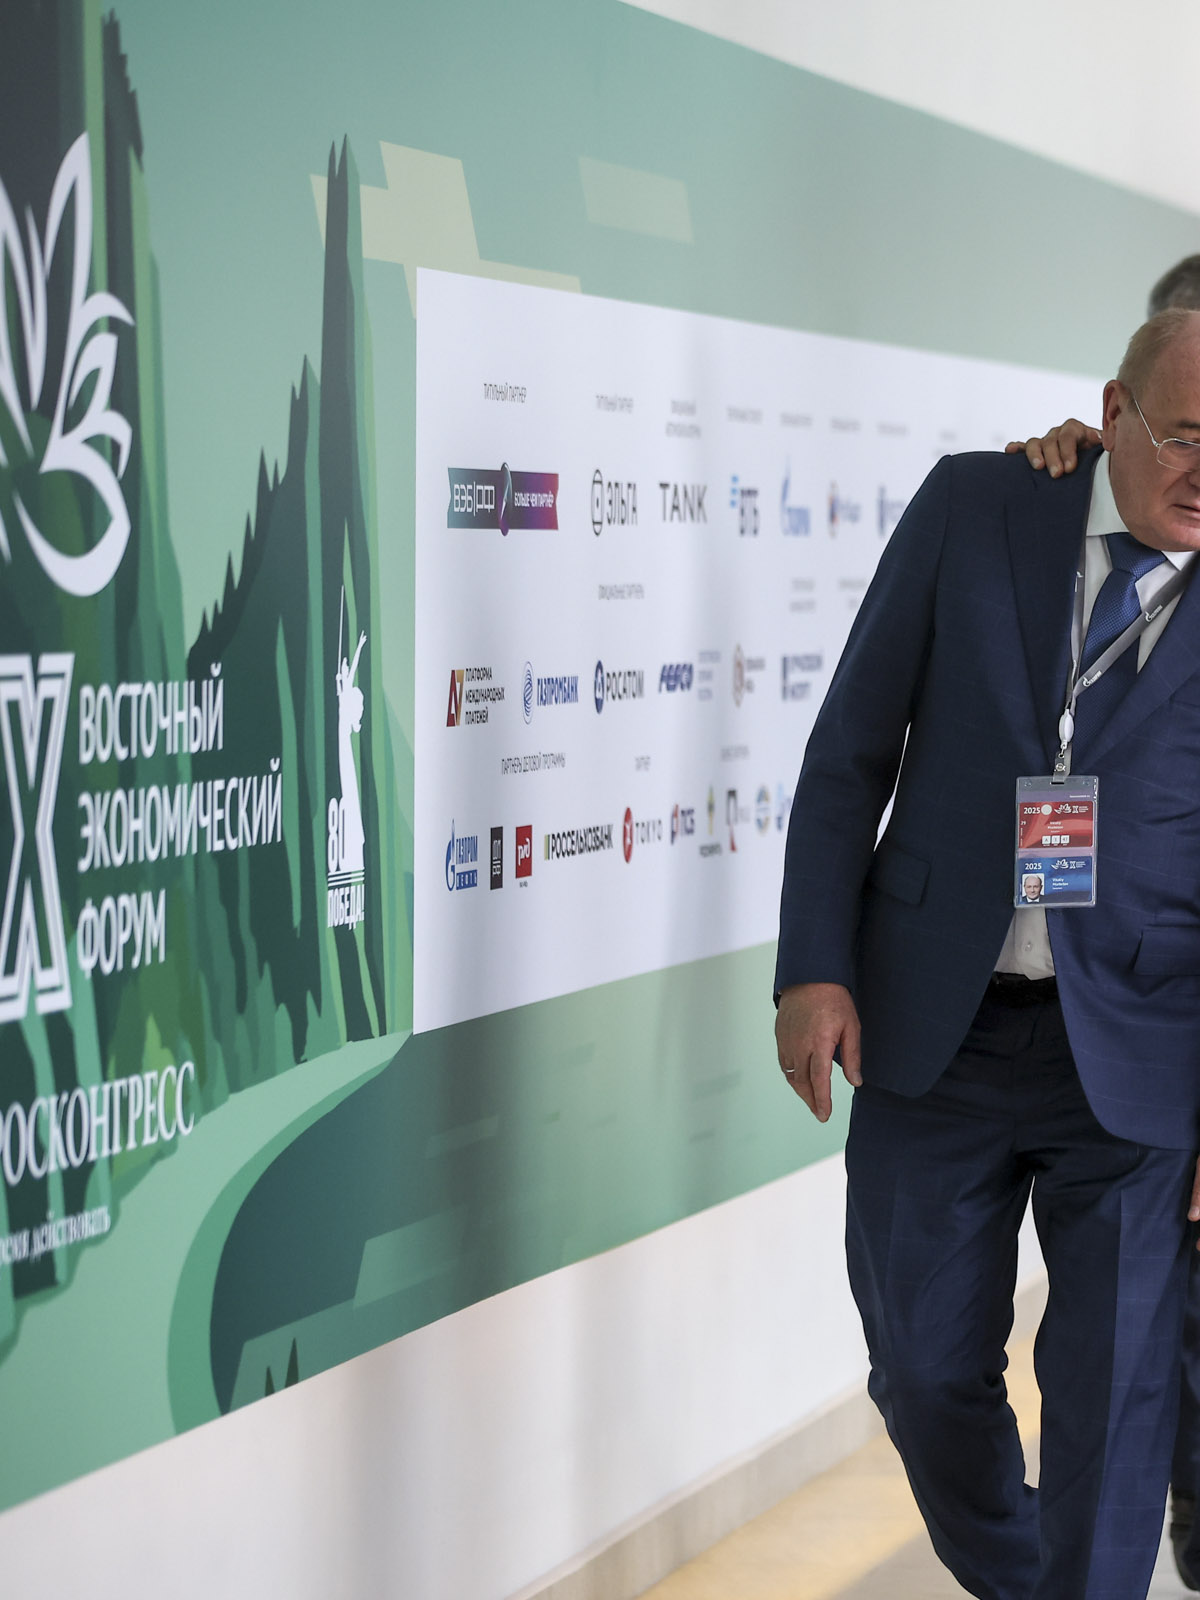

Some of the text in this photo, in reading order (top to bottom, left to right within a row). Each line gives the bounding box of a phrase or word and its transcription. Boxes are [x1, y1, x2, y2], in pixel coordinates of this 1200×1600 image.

[606, 481, 638, 526] ЭЛЬГА
[659, 482, 708, 524] TANK
[465, 667, 493, 682] ПЛАТФОРМА
[537, 675, 579, 706] ГАЗПРОМБАНК
[606, 670, 644, 701] РОСАТОМ
[79, 662, 224, 765] ВОСТОЧНЫЙ
[78, 757, 283, 873] ЭКОНОМИЧЕСКИЙ
[1023, 807, 1041, 815] 2025
[551, 824, 614, 860] РОССЕЛЬХОЗБАНК
[327, 883, 365, 930] ПОБЕДА!
[76, 889, 166, 979] ФОРУМ
